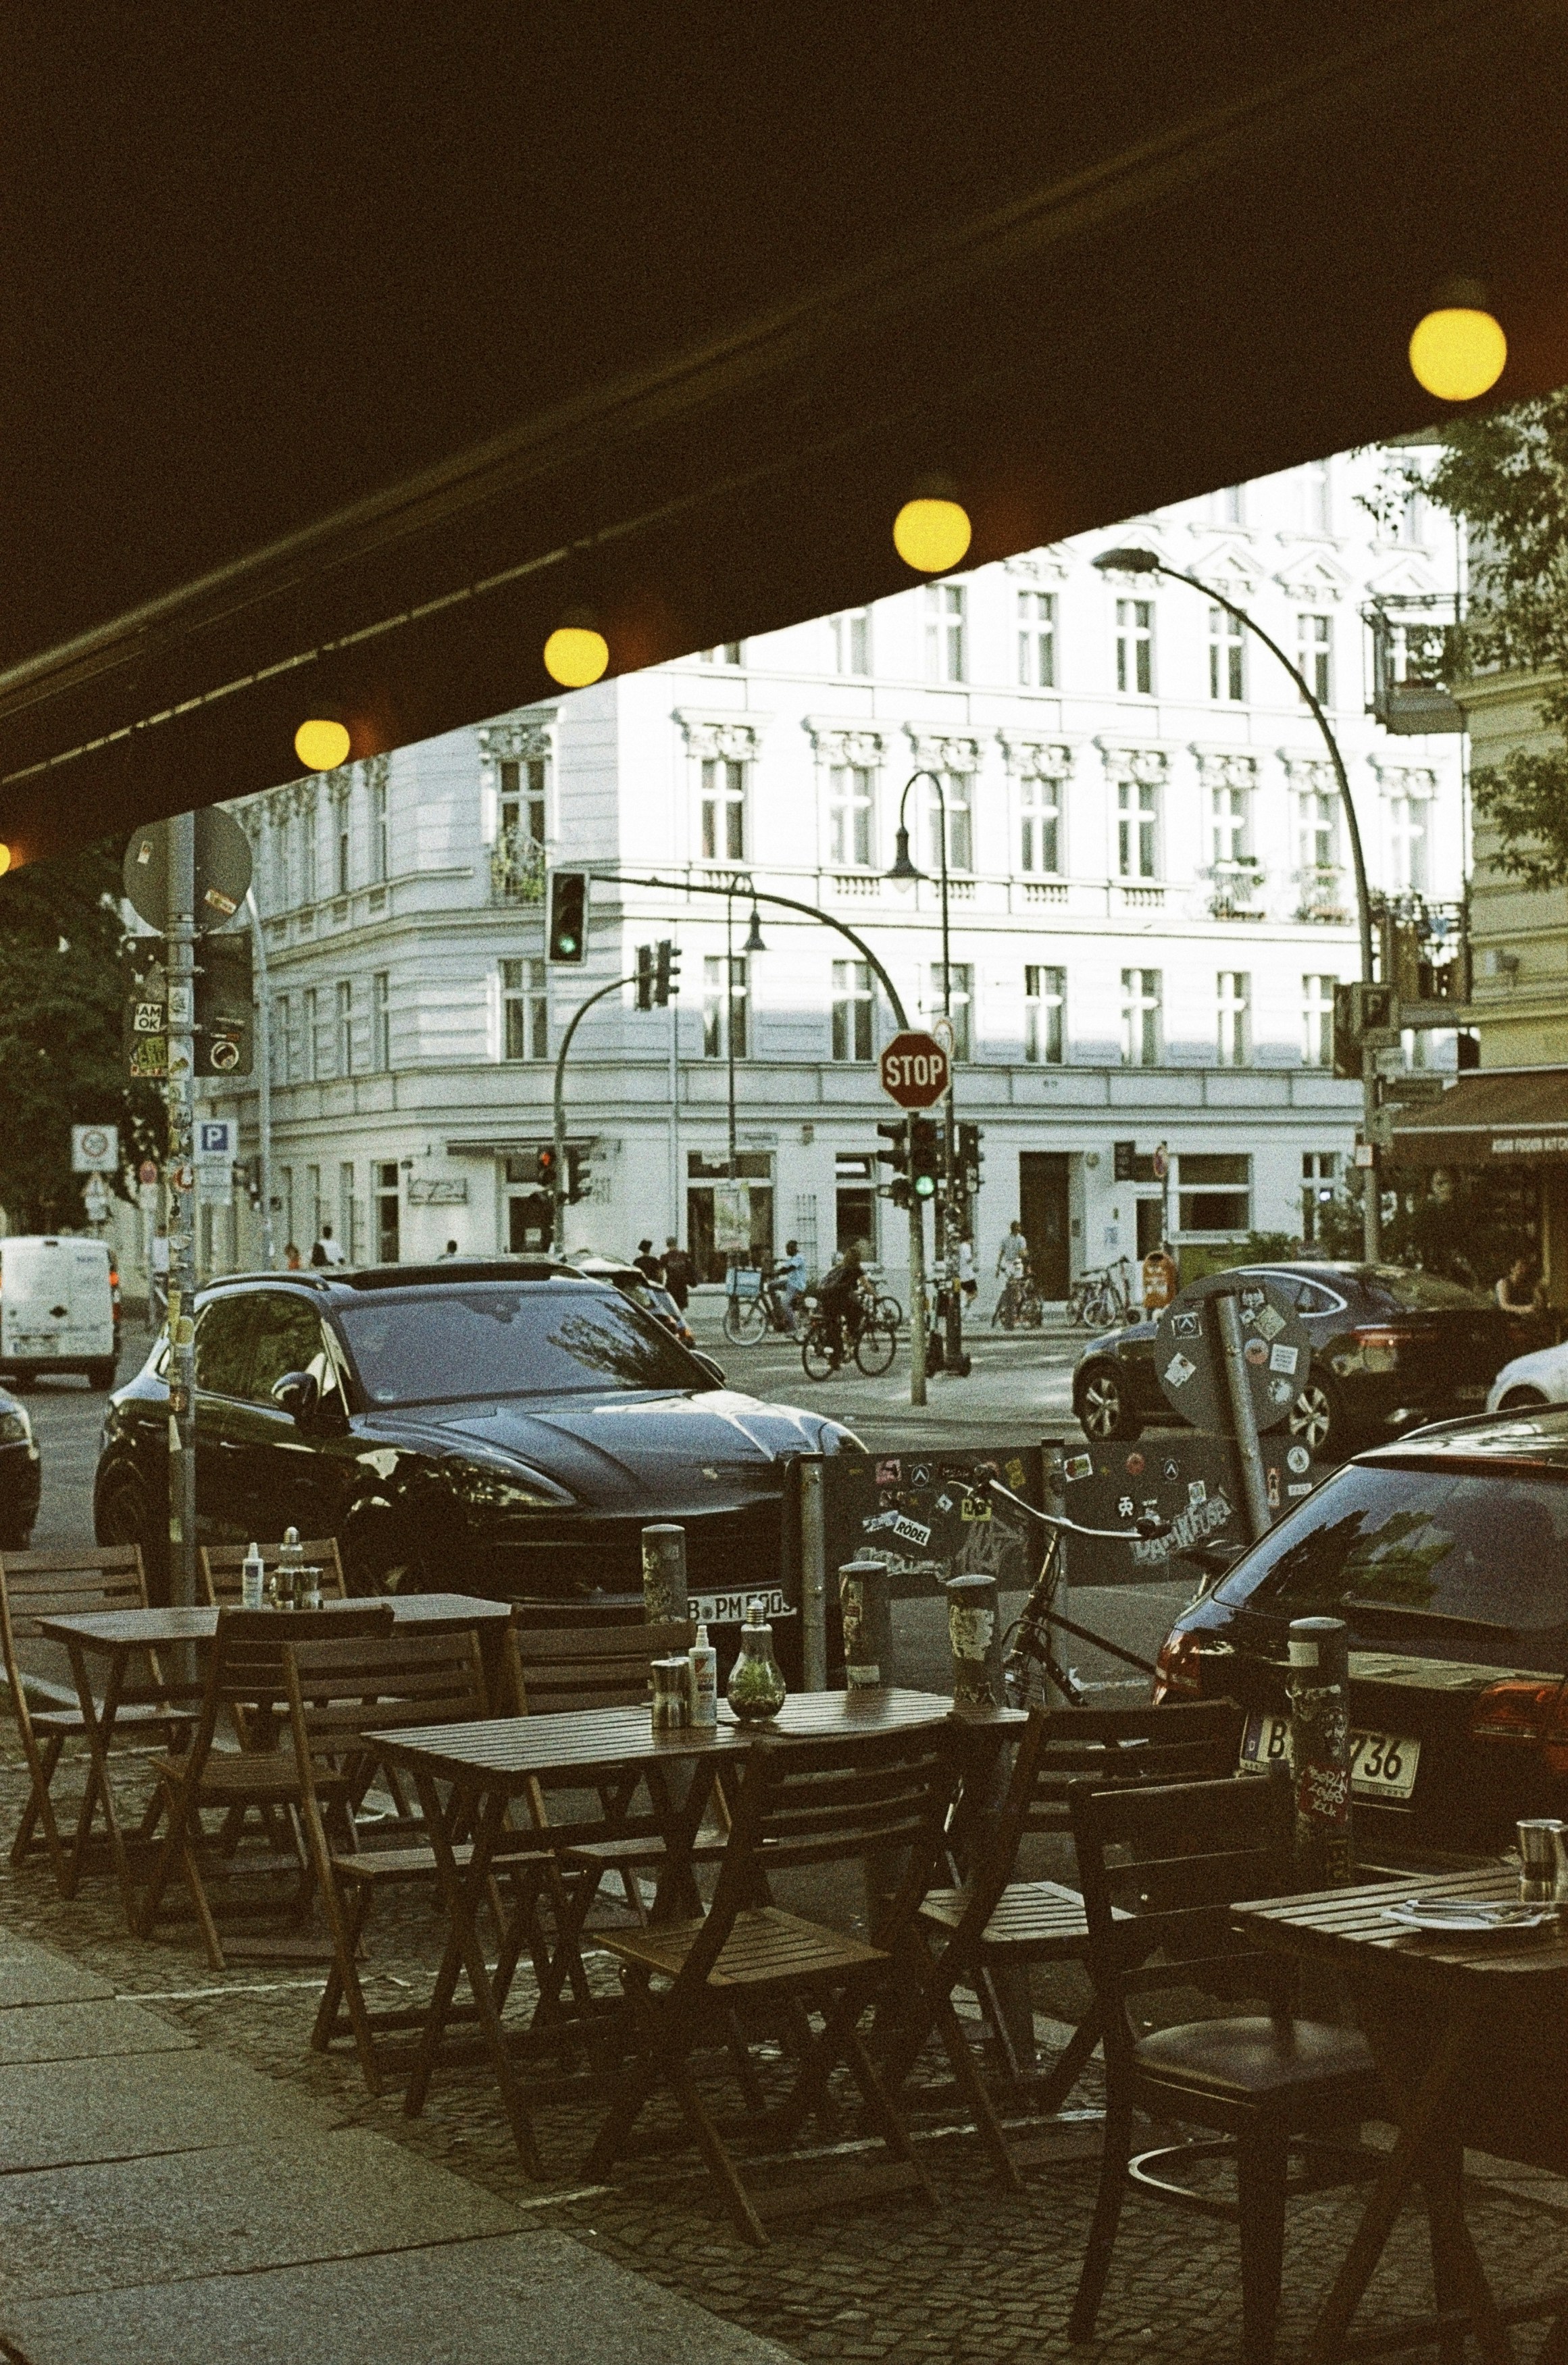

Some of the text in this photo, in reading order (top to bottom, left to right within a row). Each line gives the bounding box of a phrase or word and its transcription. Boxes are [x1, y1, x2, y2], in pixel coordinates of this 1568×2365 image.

[138, 1017, 159, 1030] OK
[886, 1054, 944, 1087] STOP
[207, 1126, 224, 1149] P
[896, 1521, 928, 1545] RÖDEL
[687, 1599, 700, 1620] B
[715, 1595, 742, 1620] PM
[1267, 1719, 1287, 1759] B
